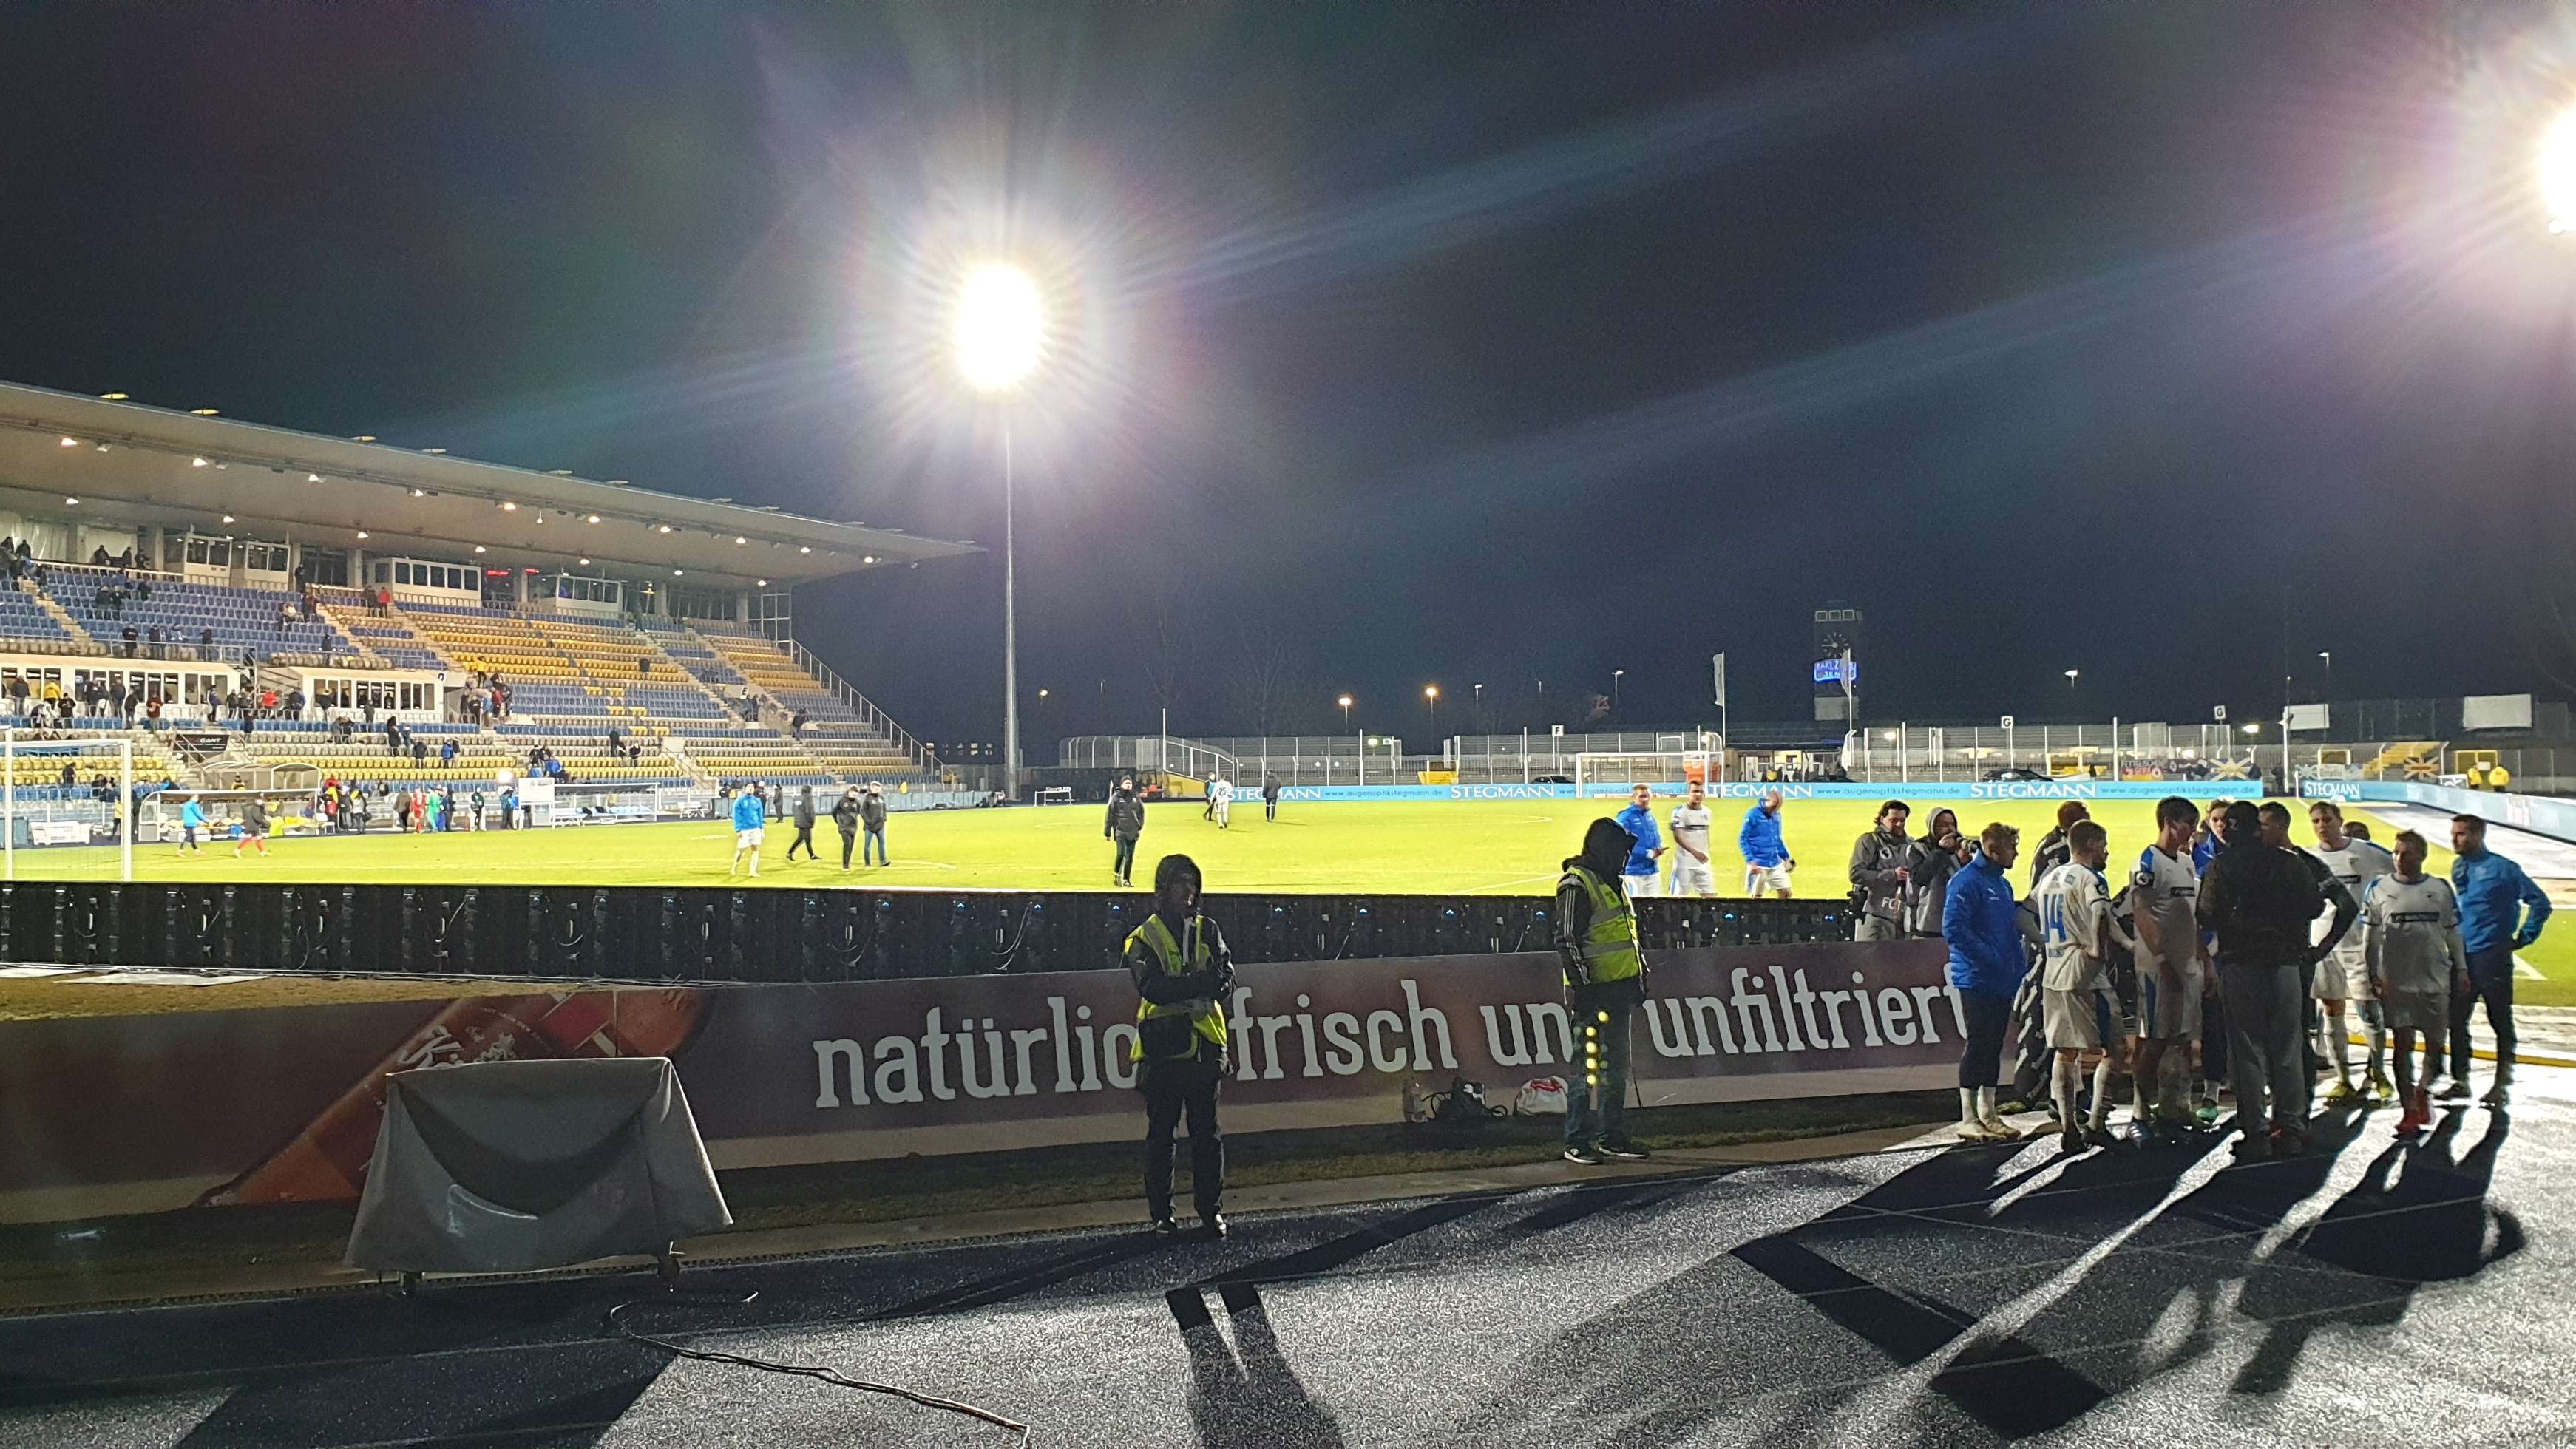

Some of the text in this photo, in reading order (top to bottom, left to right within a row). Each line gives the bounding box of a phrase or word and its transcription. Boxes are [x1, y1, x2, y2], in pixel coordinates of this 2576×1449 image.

[2003, 717, 2012, 727] G
[1555, 727, 1560, 735] F
[1451, 784, 1554, 798] STEGMANN
[1817, 785, 1960, 796] www.augenoptikstegmann.de
[1970, 783, 2095, 798] STEGMANN
[2305, 781, 2361, 797] STEGMANN
[2043, 893, 2067, 943] 14
[813, 963, 1968, 1109] natürlic frisch un unfiltriert
